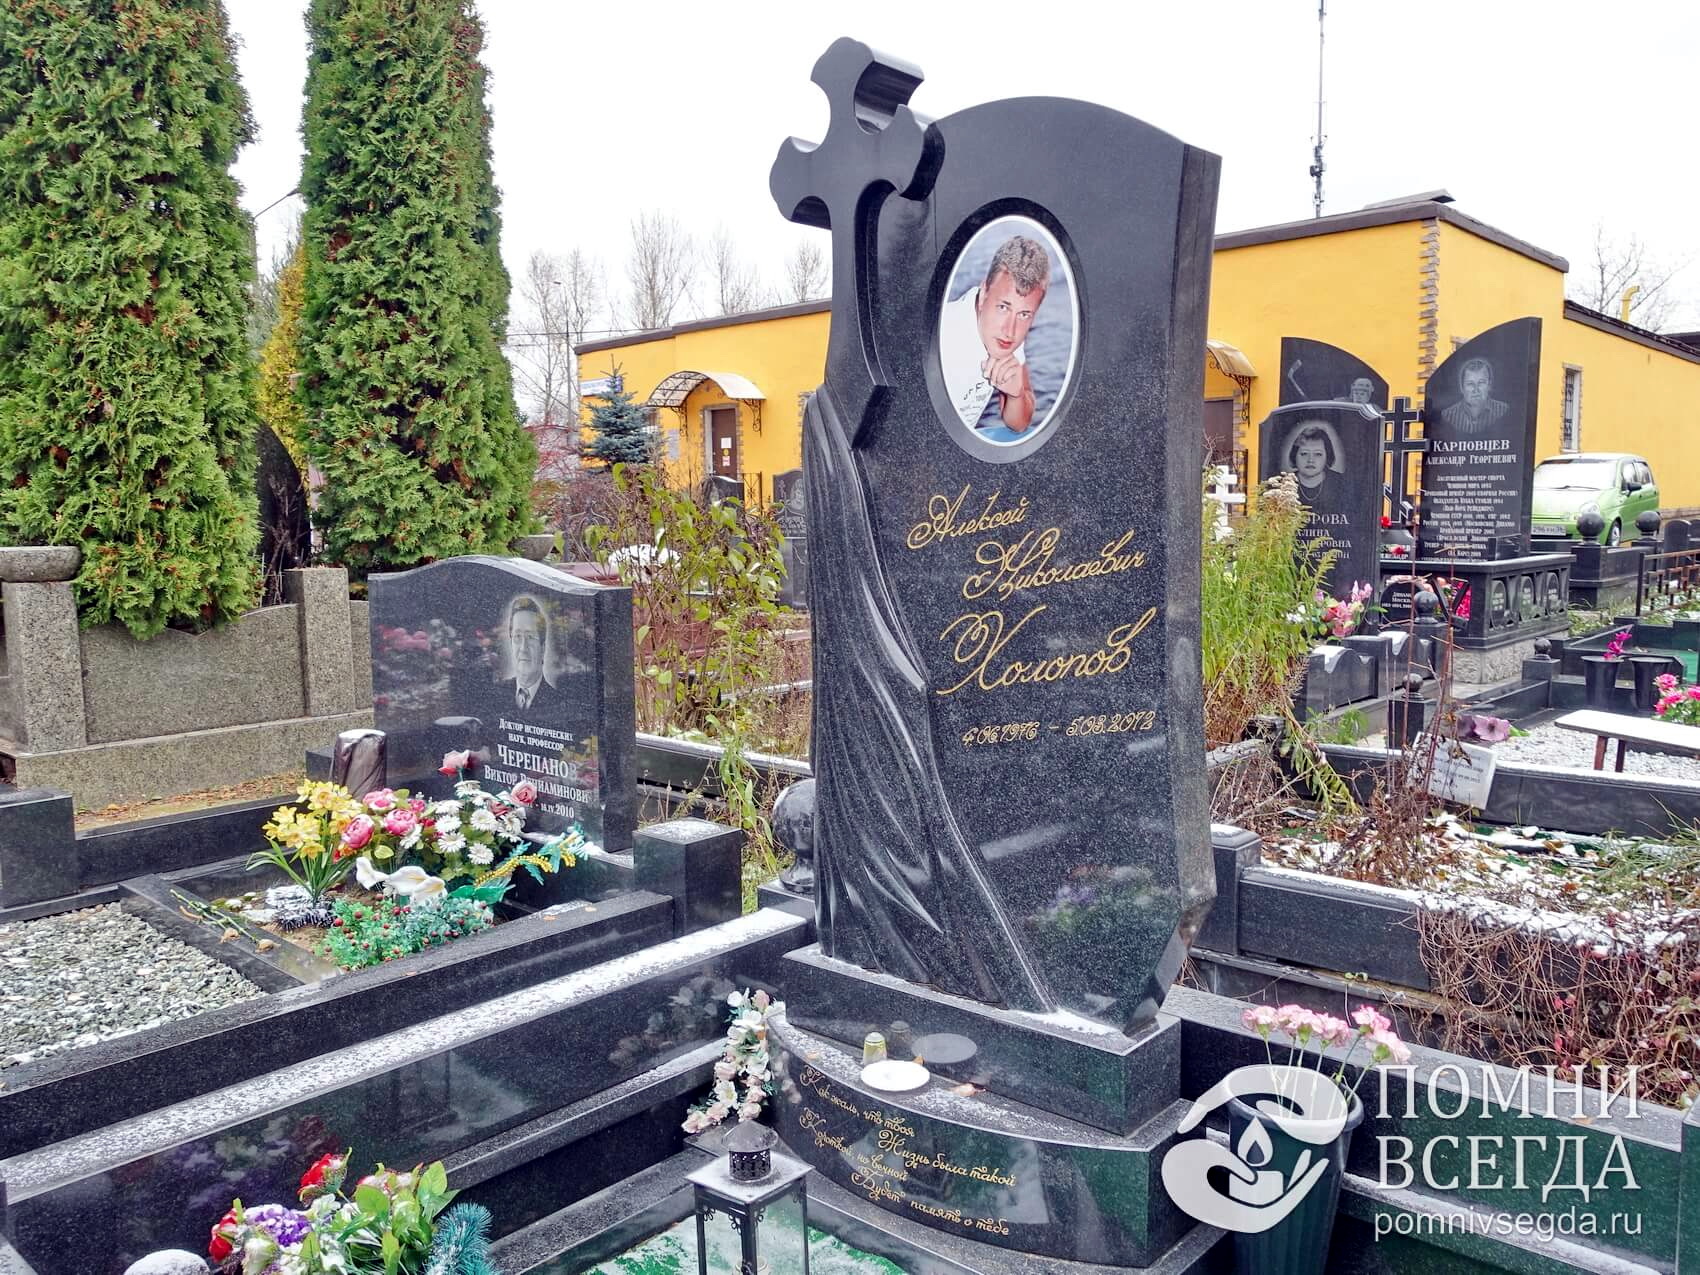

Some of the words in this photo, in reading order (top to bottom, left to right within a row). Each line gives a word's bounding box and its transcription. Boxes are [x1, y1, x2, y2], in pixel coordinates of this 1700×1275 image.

[1433, 440, 1510, 452] КАРПОВЦЕВ
[906, 484, 1029, 550] Алексей
[962, 527, 1145, 602] Николаевич
[936, 605, 1158, 695] Холопов
[498, 718, 524, 733] ДОКТОР
[524, 723, 574, 742] ИСТОРИЧЕСКИХ
[508, 732, 526, 746] НАУК,
[527, 737, 565, 752] ПРОФЕССОР
[484, 764, 519, 786] ВИКТОР
[497, 744, 577, 782] ЧЕРЕПАНОВ
[877, 1130, 930, 1169] Жизнь
[932, 1153, 968, 1176] была
[969, 1165, 1017, 1188] такой
[910, 1199, 961, 1224] память
[975, 1217, 1010, 1237] тебе
